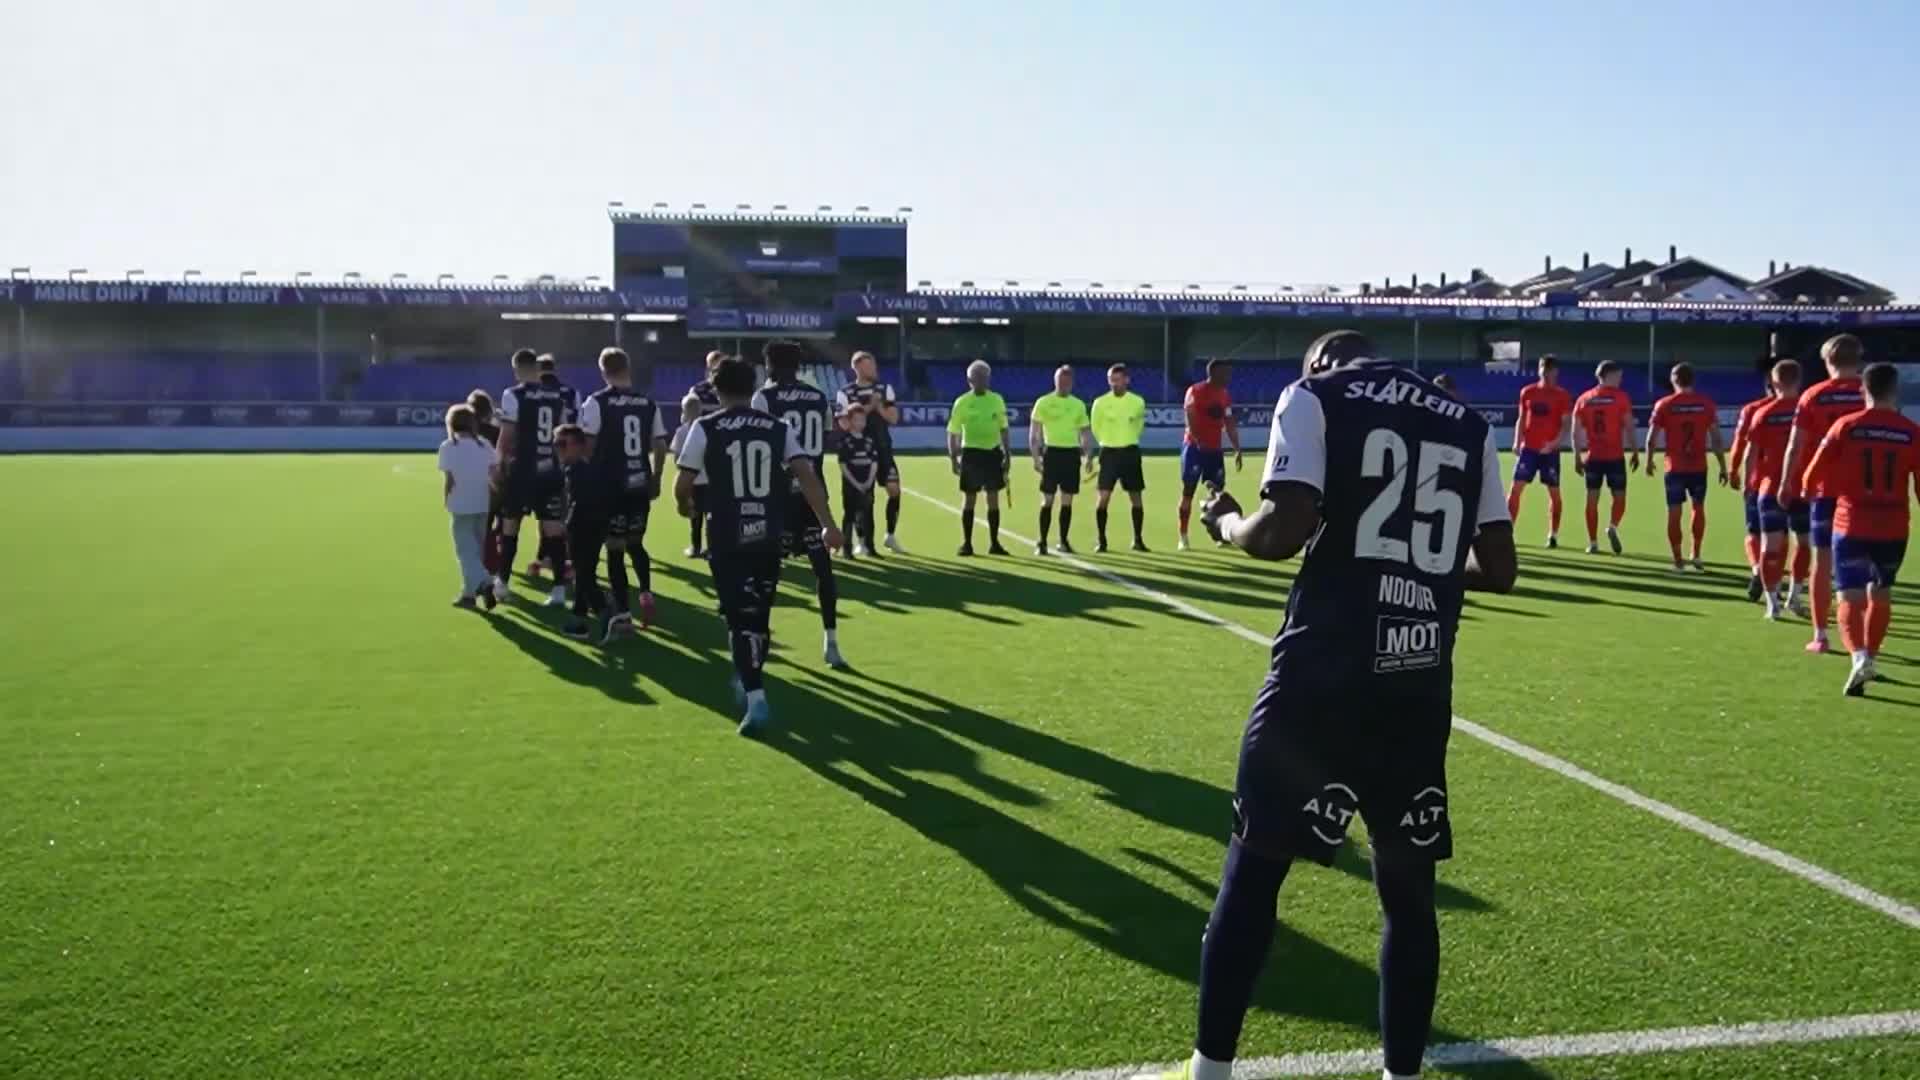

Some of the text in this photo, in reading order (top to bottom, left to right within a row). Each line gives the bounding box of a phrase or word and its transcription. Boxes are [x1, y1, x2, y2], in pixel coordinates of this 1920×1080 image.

[96, 287, 150, 302] DRIFT
[227, 288, 280, 303] DRIFT
[644, 295, 688, 307] VARIG
[885, 298, 929, 310] VARIG
[962, 299, 1004, 311] VARIG
[1034, 301, 1076, 312] VARIG
[1105, 302, 1148, 313] VARIG
[1180, 302, 1220, 314] VARIG
[745, 312, 821, 327] TRIBUNEN
[537, 406, 553, 444] 9
[623, 415, 643, 457] 8
[725, 439, 772, 499] 10
[1355, 428, 1468, 575] 25
[1378, 574, 1437, 611] NDOUR
[1387, 621, 1440, 653] MOT
[1303, 798, 1352, 826] ALT
[1400, 806, 1444, 826] ALT
